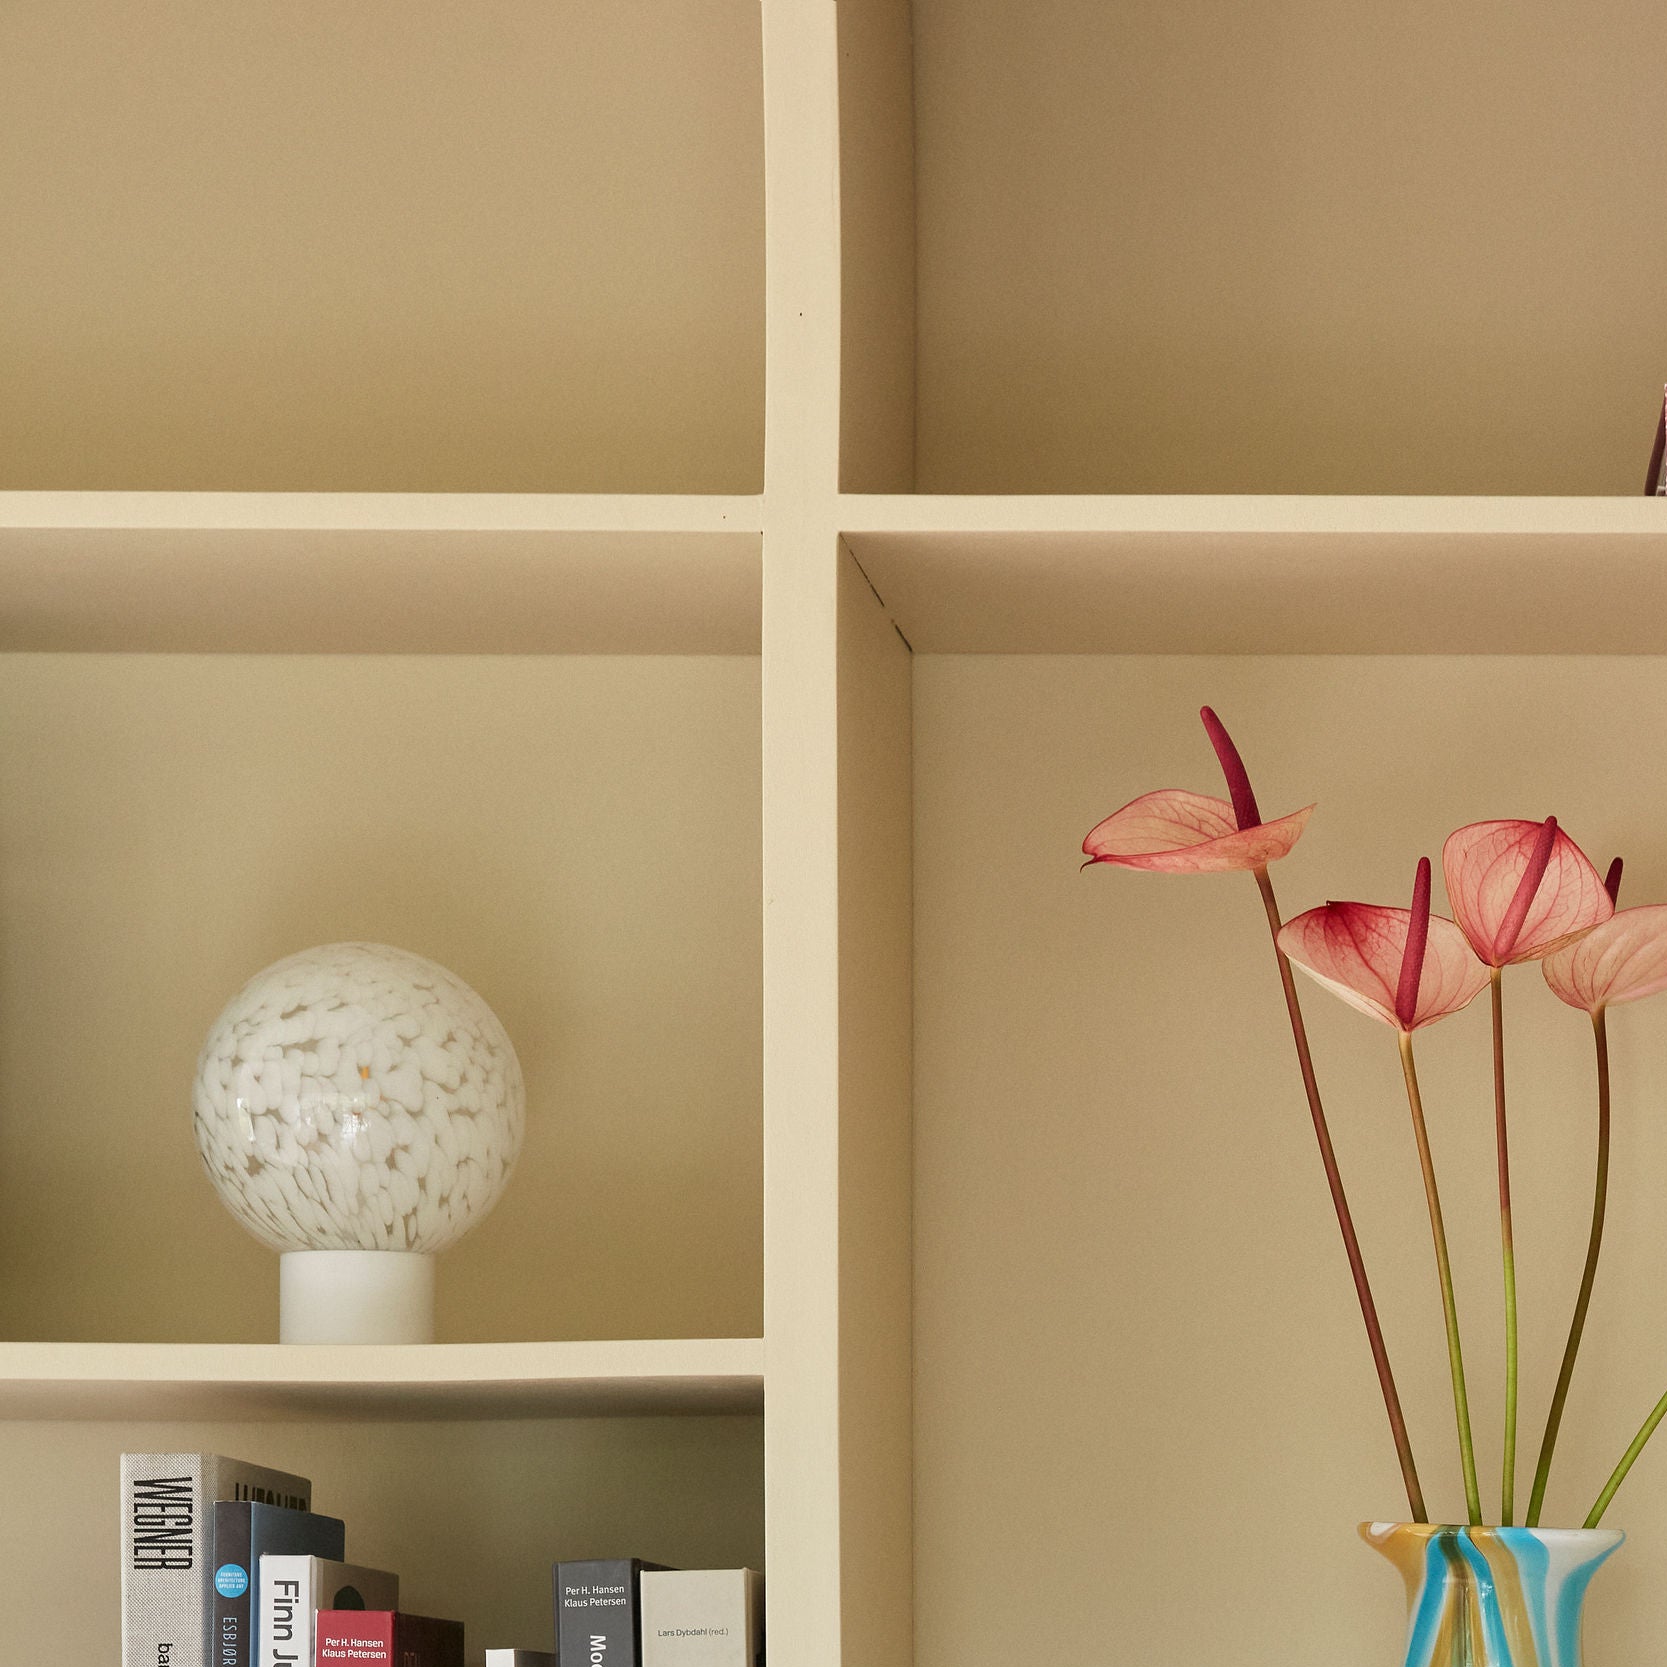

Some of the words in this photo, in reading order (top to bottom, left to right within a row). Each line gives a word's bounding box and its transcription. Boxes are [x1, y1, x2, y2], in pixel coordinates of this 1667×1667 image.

[133, 1476, 193, 1571] WEGNER
[565, 1586, 581, 1596] Per
[581, 1585, 591, 1596] H.
[592, 1585, 625, 1595] Hansen
[564, 1598, 588, 1608] Klaus
[589, 1596, 627, 1608] Petersen
[273, 1579, 299, 1642] Finn
[657, 1629, 674, 1637] Lars
[675, 1627, 708, 1638] Dybdahl
[708, 1627, 729, 1637] (red.)
[325, 1637, 341, 1647] Per
[341, 1637, 350, 1647] H.
[350, 1638, 384, 1648] Hansen
[322, 1648, 346, 1659] Klaus
[347, 1649, 387, 1660] Petersen
